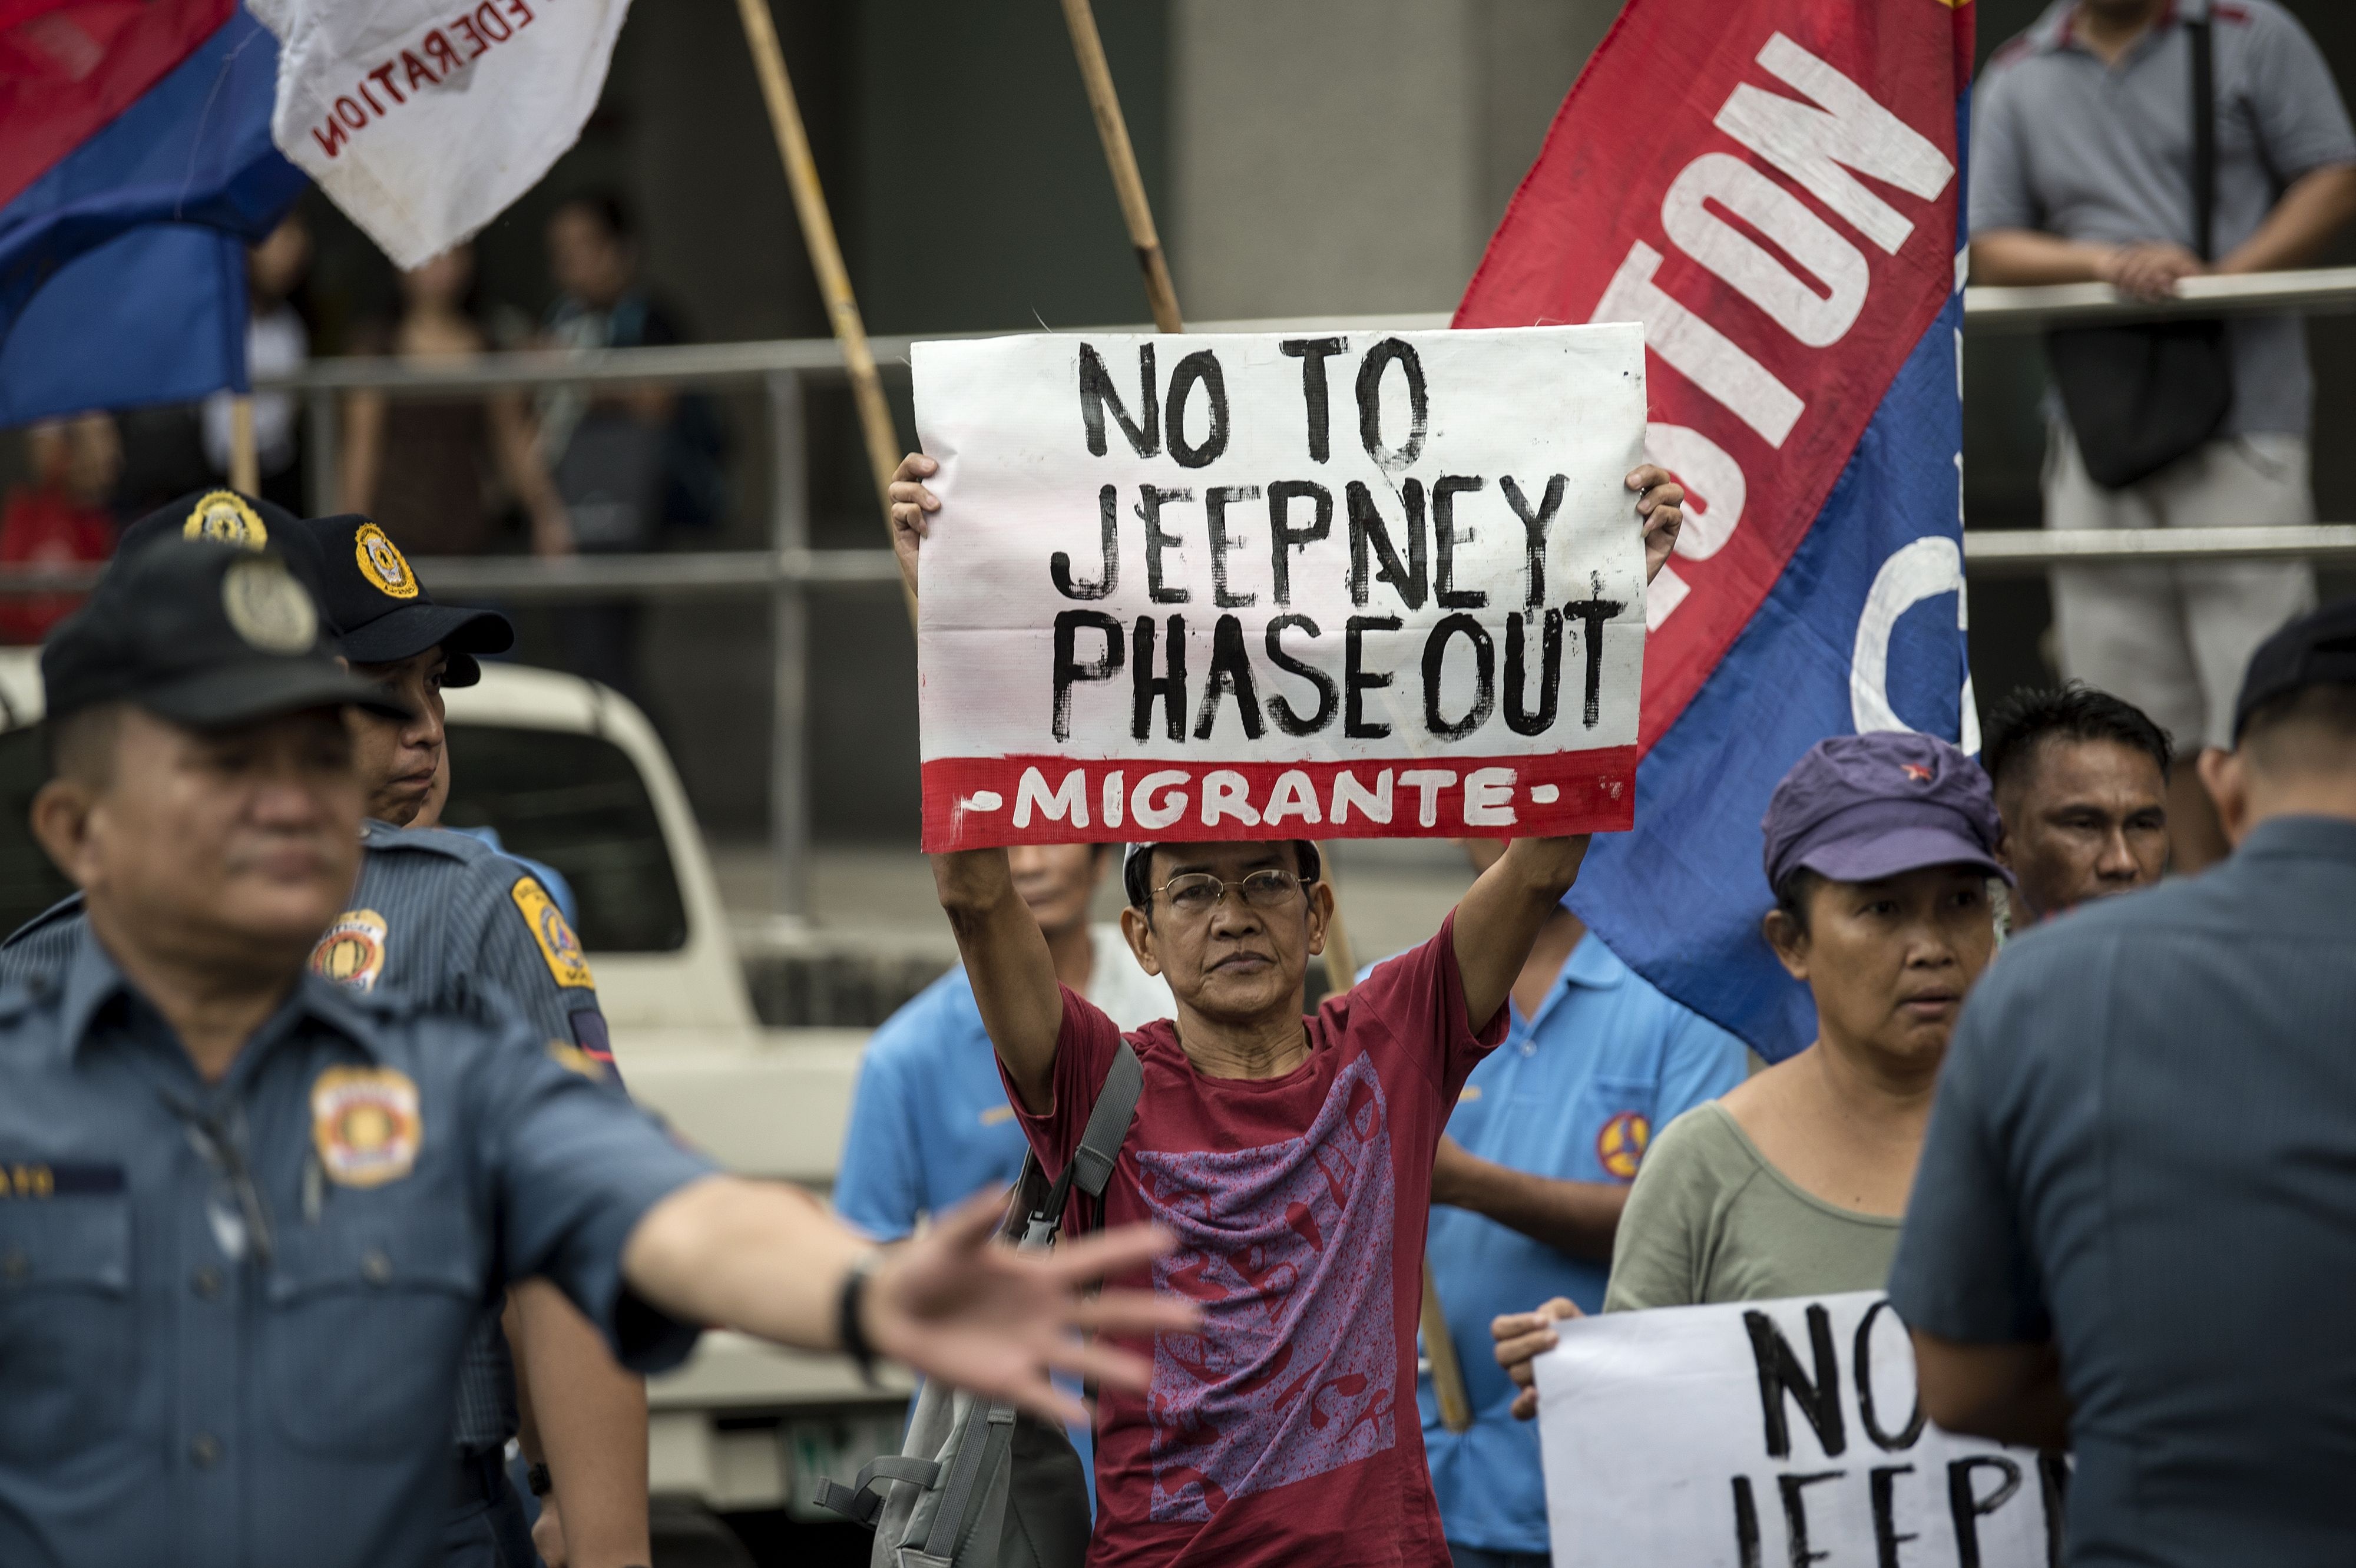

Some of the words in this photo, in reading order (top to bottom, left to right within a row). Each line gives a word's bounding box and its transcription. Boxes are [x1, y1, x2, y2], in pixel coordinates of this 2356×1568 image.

[1079, 340, 1229, 468] NO
[1280, 336, 1429, 471] TO
[1050, 474, 1569, 613] JEEPNEY
[1743, 1302, 1927, 1459] NO
